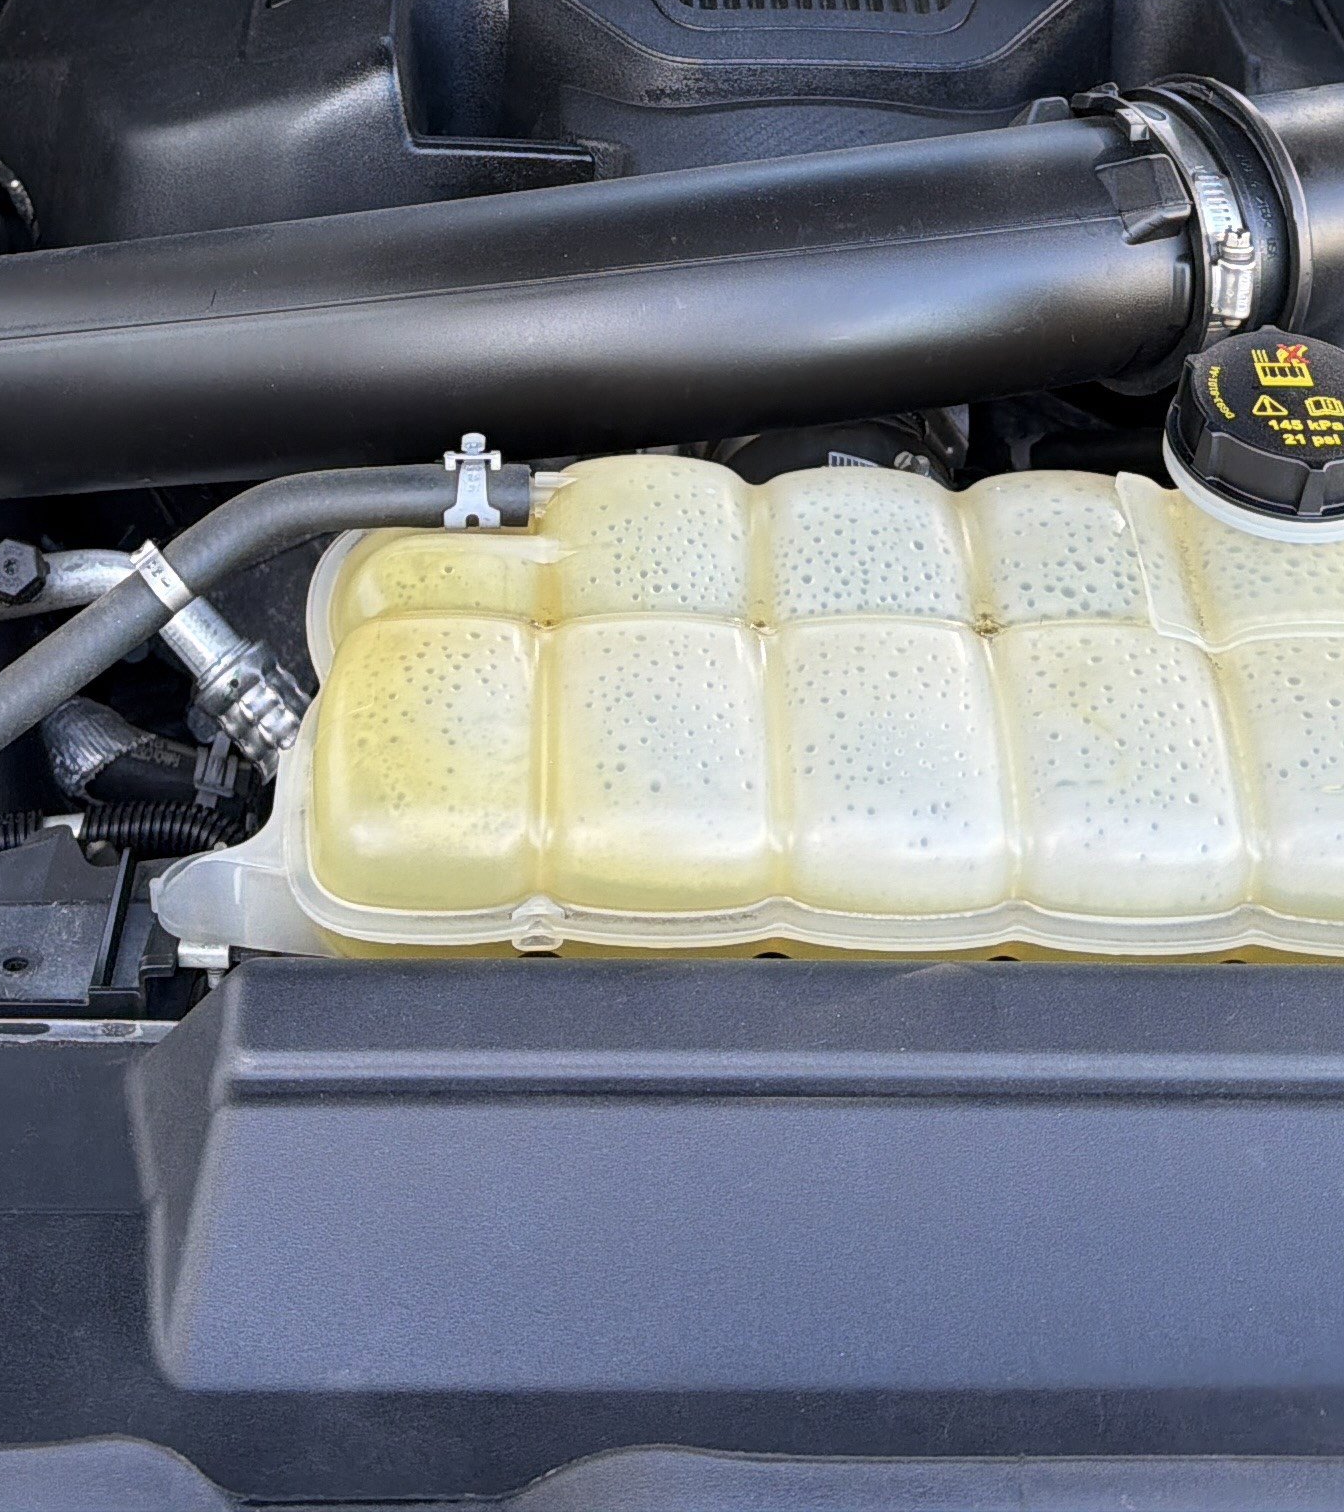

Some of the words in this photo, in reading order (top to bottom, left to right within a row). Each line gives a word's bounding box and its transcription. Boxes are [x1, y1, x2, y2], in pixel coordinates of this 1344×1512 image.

[1268, 419, 1304, 432] 145
[1308, 419, 1344, 432] kPa
[1283, 433, 1306, 445] 21
[1312, 433, 1342, 447] psi
